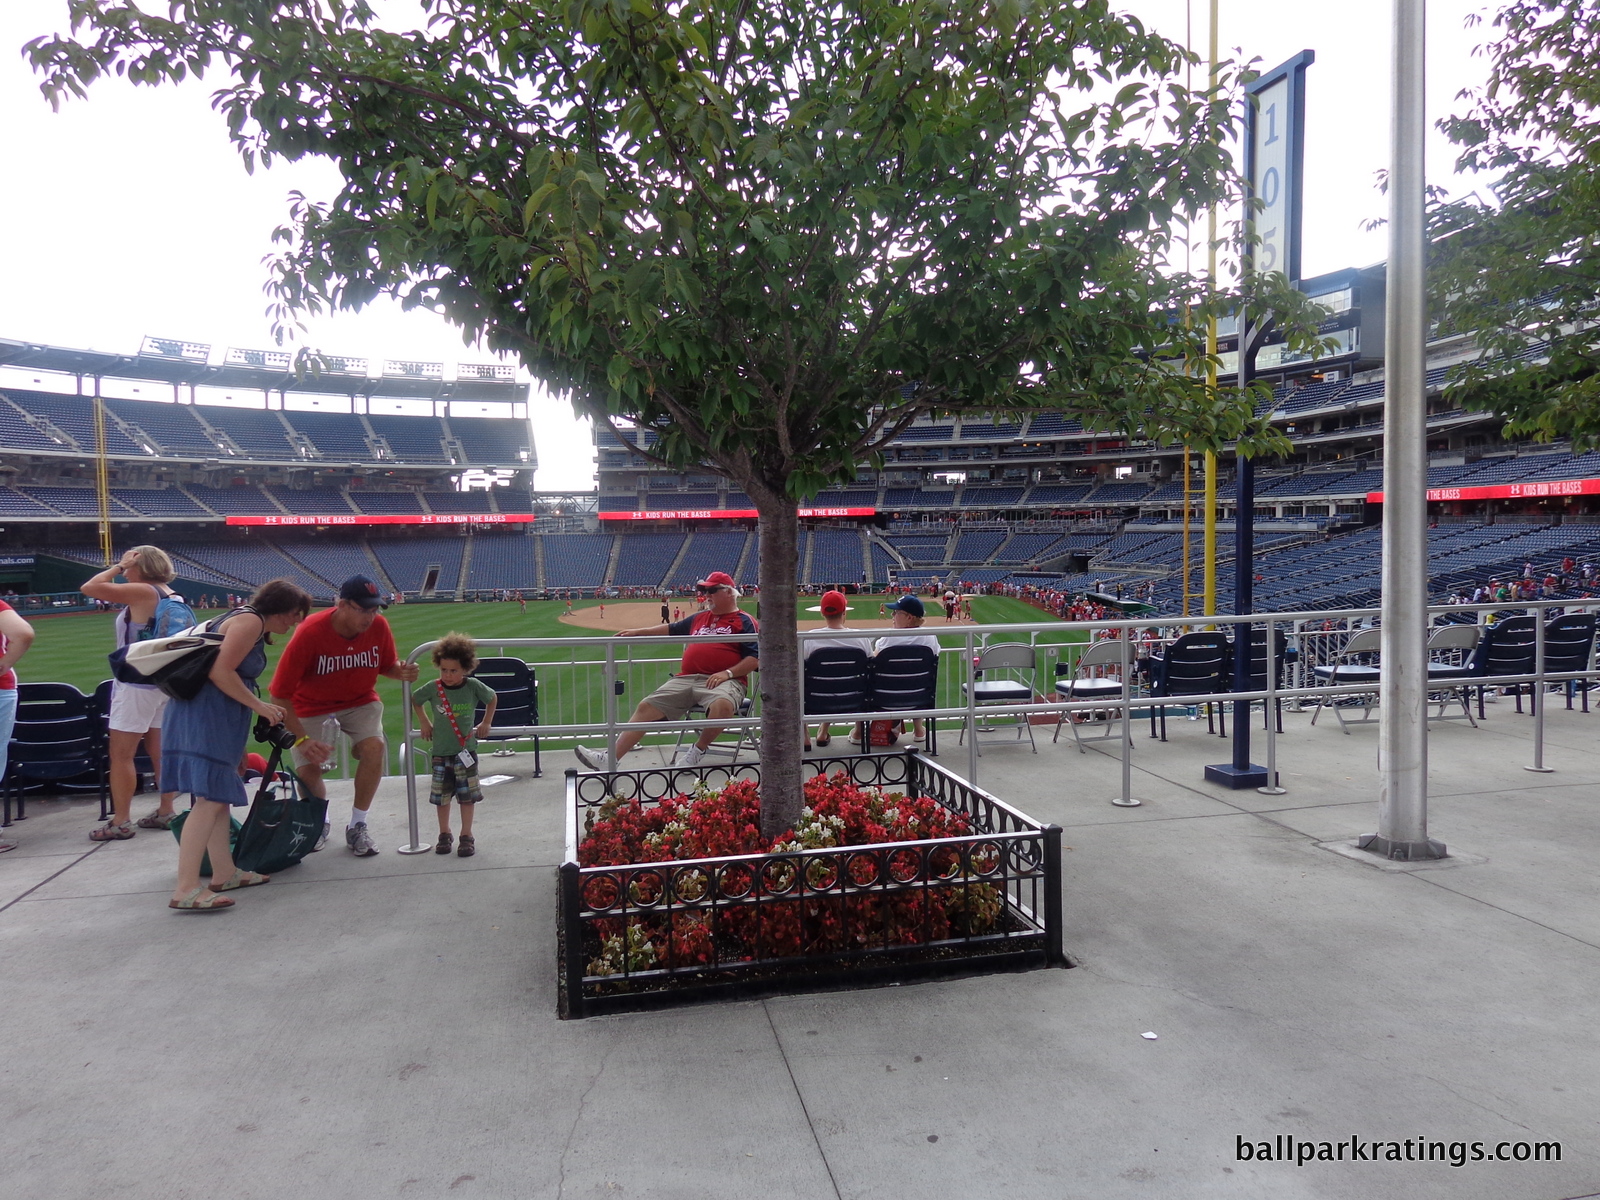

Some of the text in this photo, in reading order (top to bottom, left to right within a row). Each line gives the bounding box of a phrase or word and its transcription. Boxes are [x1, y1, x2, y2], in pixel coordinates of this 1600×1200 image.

[1261, 102, 1280, 271] 105
[1523, 481, 1582, 496] KIDS RUN THE BASES
[1429, 490, 1440, 500] THE
[1441, 489, 1460, 499] BASES
[645, 511, 660, 519] KIDS
[691, 510, 711, 518] BASES
[828, 508, 848, 516] BASES
[333, 516, 356, 524] BASES
[317, 645, 379, 675] NATIONALS
